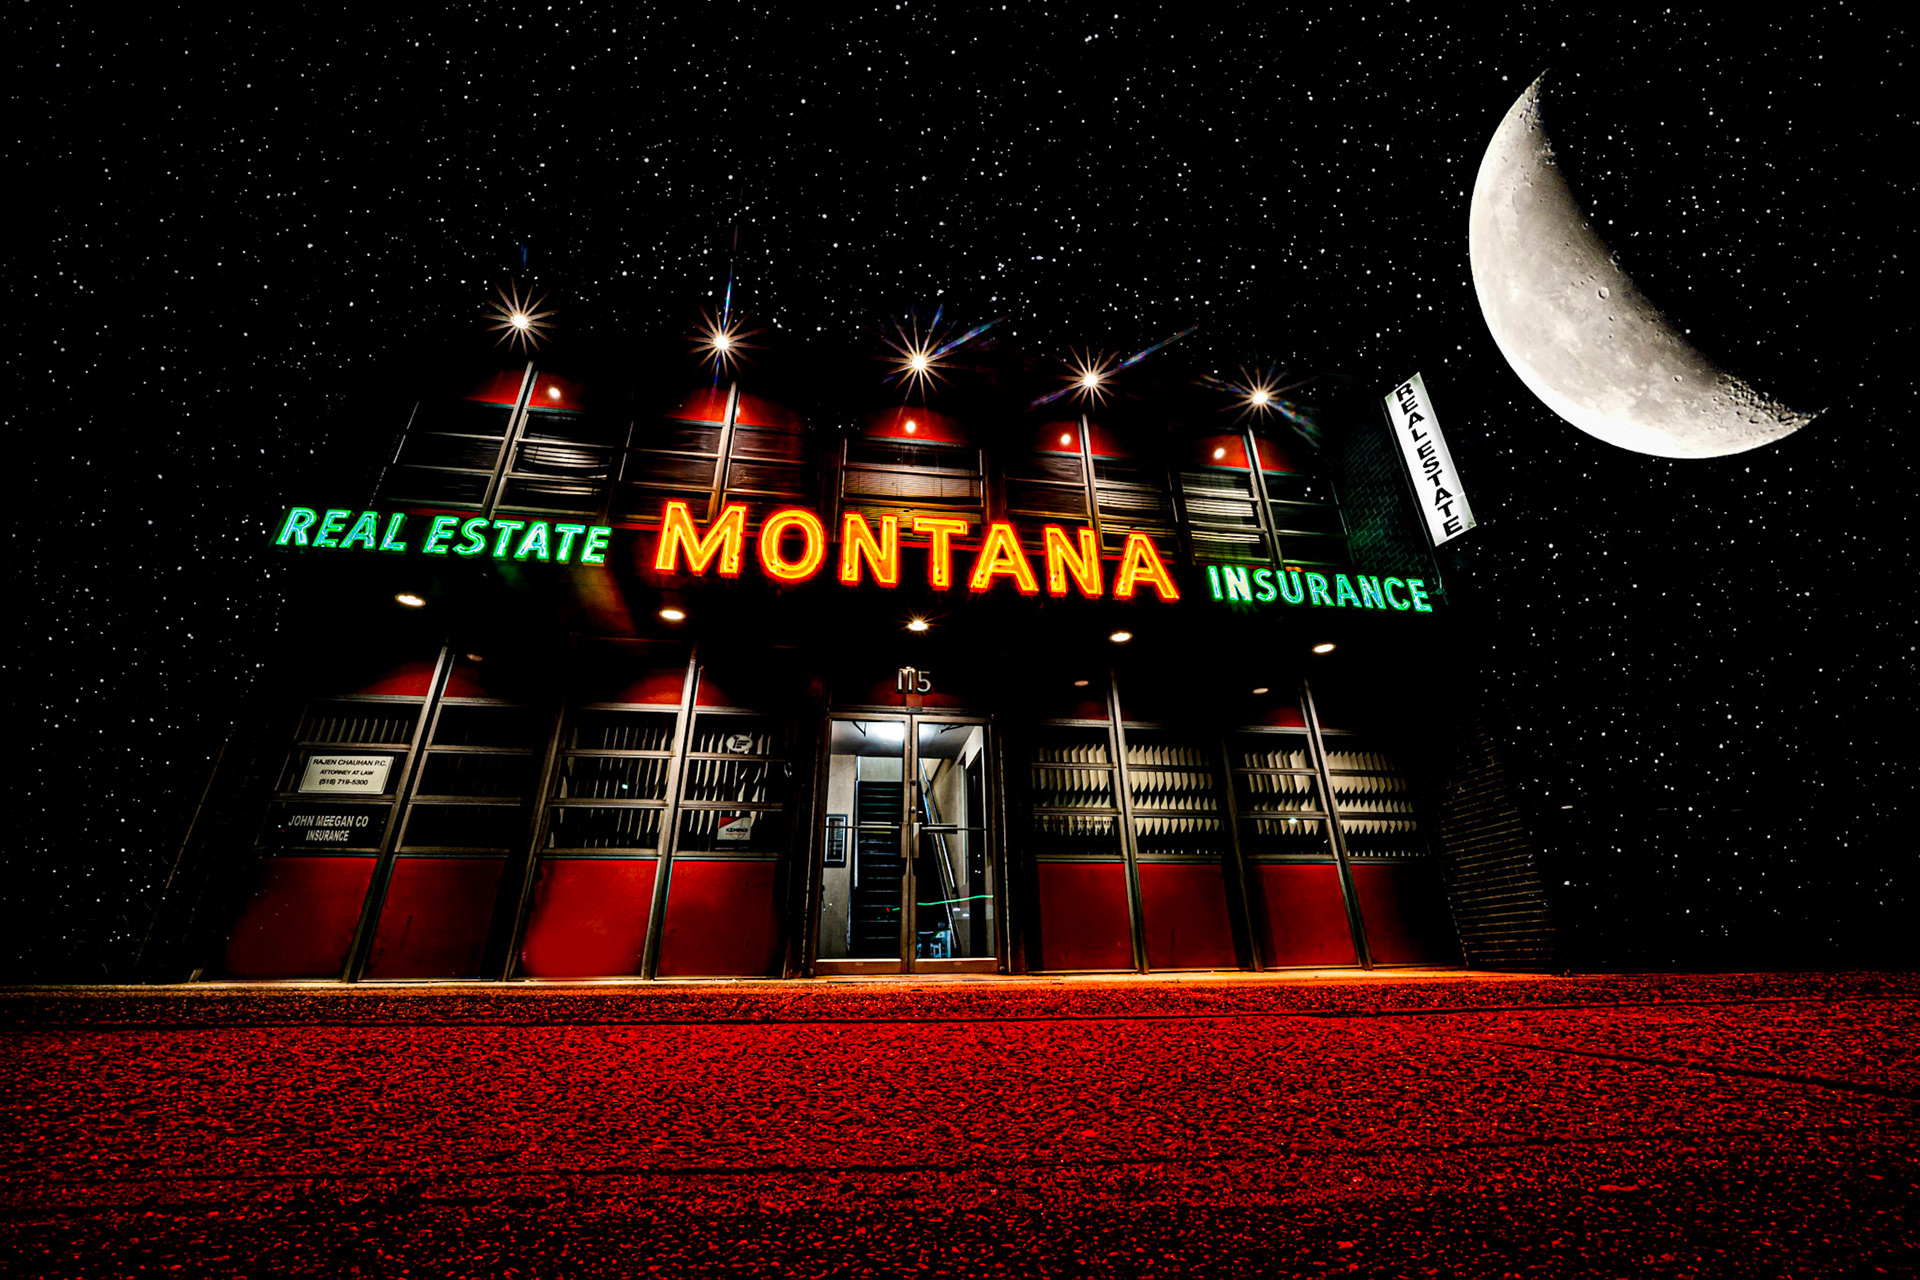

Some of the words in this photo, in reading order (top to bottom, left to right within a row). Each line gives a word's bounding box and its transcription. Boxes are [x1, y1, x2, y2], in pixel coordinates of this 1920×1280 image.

[1395, 382, 1428, 443] REAL
[1416, 440, 1463, 537] ESTATE
[275, 506, 407, 551] REAL
[422, 515, 613, 567] ESTATE
[655, 500, 1180, 601] MONTANA
[1206, 564, 1434, 613] INSURANCE
[897, 667, 932, 693] 115
[312, 758, 337, 766] RAJEN
[338, 758, 373, 767] CHAUHAN
[374, 759, 388, 767] P.C.
[287, 814, 316, 827] JOHN
[315, 815, 354, 828] MEEGAN
[355, 815, 370, 828] CO
[305, 829, 350, 842] INSURANCE
